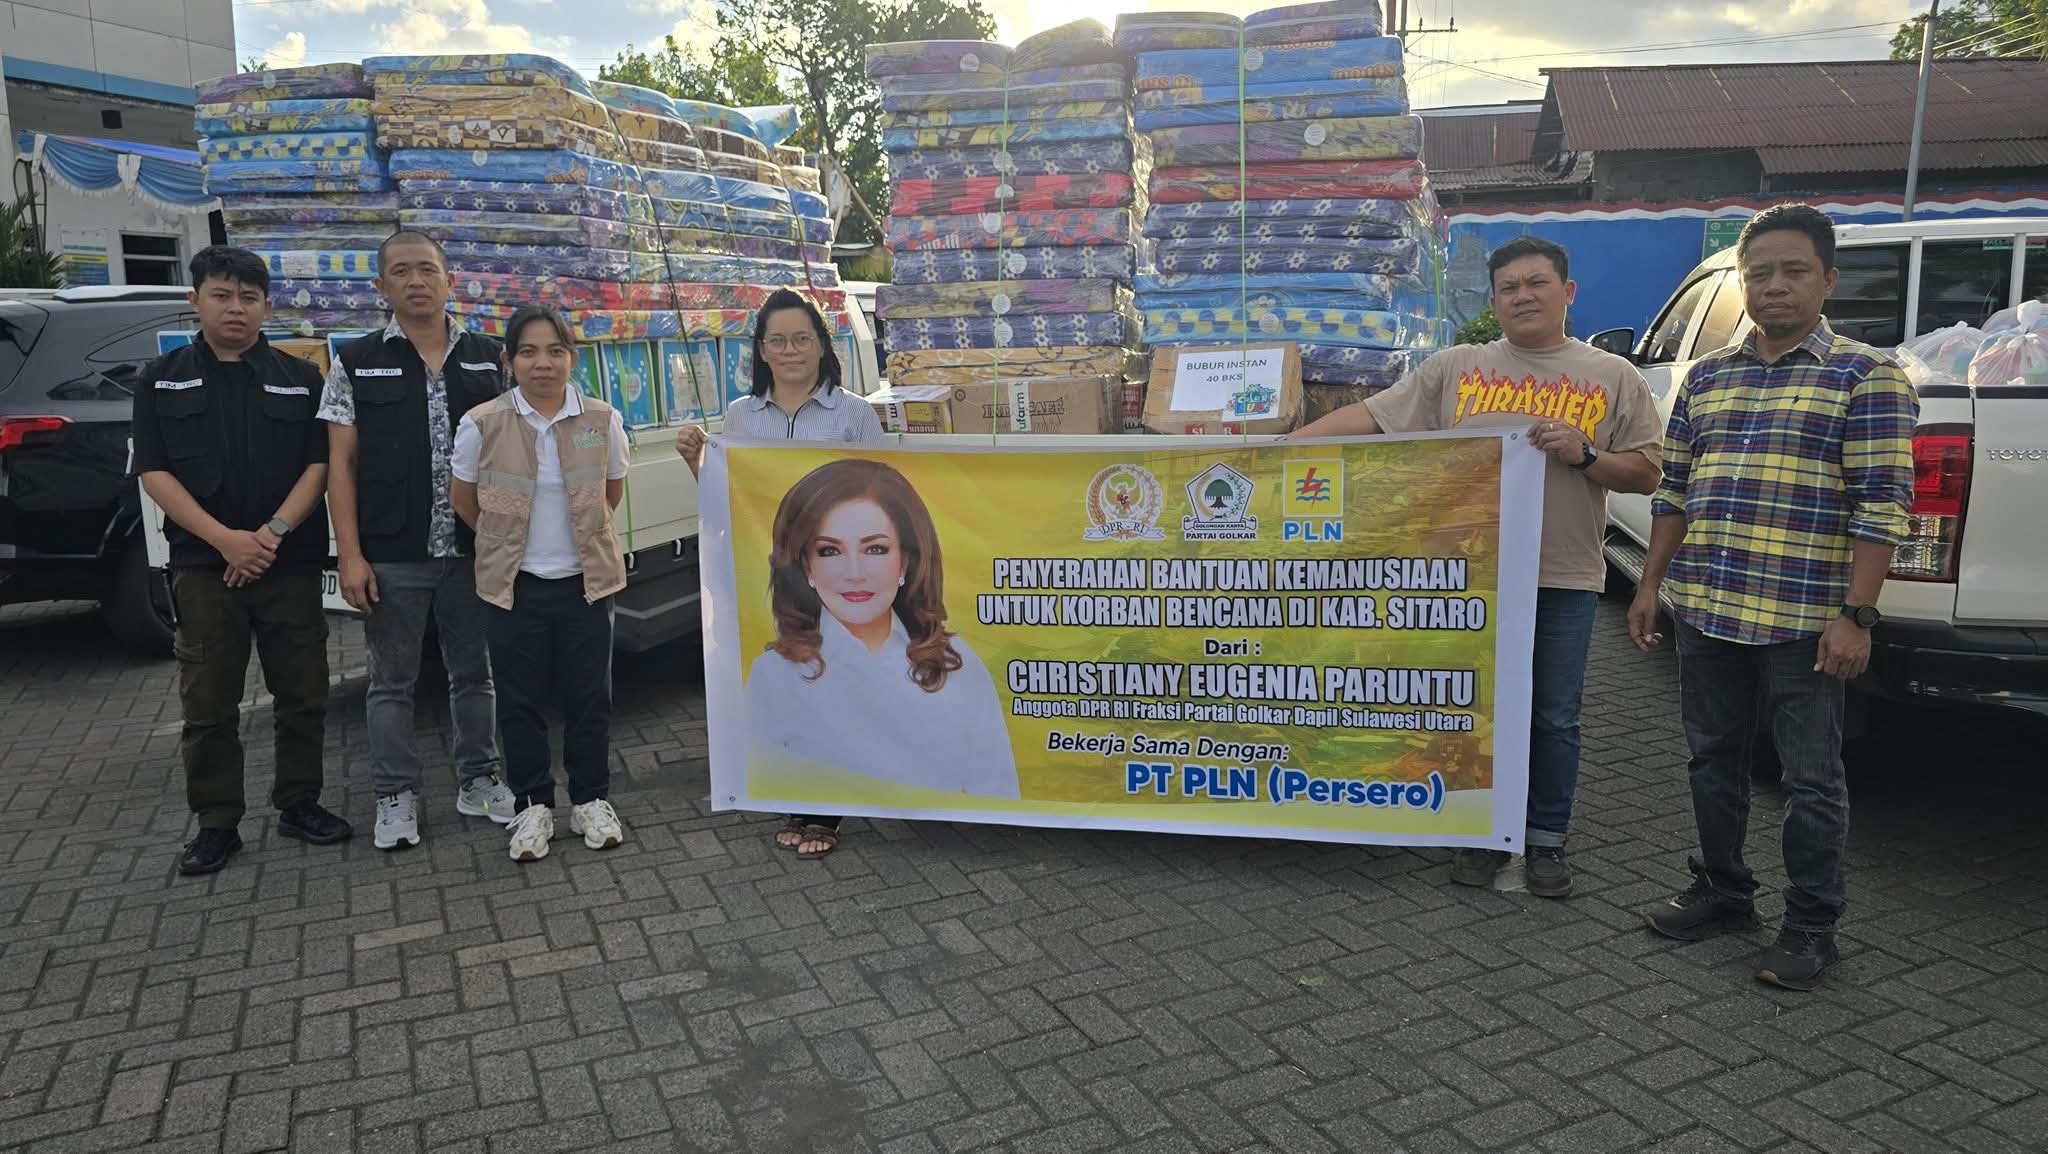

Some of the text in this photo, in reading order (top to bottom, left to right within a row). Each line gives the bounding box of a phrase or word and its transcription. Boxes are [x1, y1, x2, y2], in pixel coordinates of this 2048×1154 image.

[1186, 359, 1268, 371] BUBUR INSTAN
[1222, 373, 1243, 381] BKS
[1453, 367, 1609, 445] THRASHER
[1186, 532, 1256, 540] PARTAI GOLKAR
[1283, 522, 1343, 541] PLN
[993, 557, 1467, 591] PENYERAHAN BANTUAN KEMANUSIAAN
[977, 594, 1486, 631] UNTUK KORBAN BENCANA DI KAB. SITARO
[1204, 638, 1248, 656] Dari
[1007, 660, 1474, 706] CHRISTIANY EUGENIA PARUNTU
[1013, 697, 1474, 731] Anggota DPR RI Fraksi Partai Golkar Dapil Sulawesi Utara
[1048, 731, 1290, 763] Bekerja Sama Dengan:
[1126, 762, 1445, 813] PT PLN (Persero)
